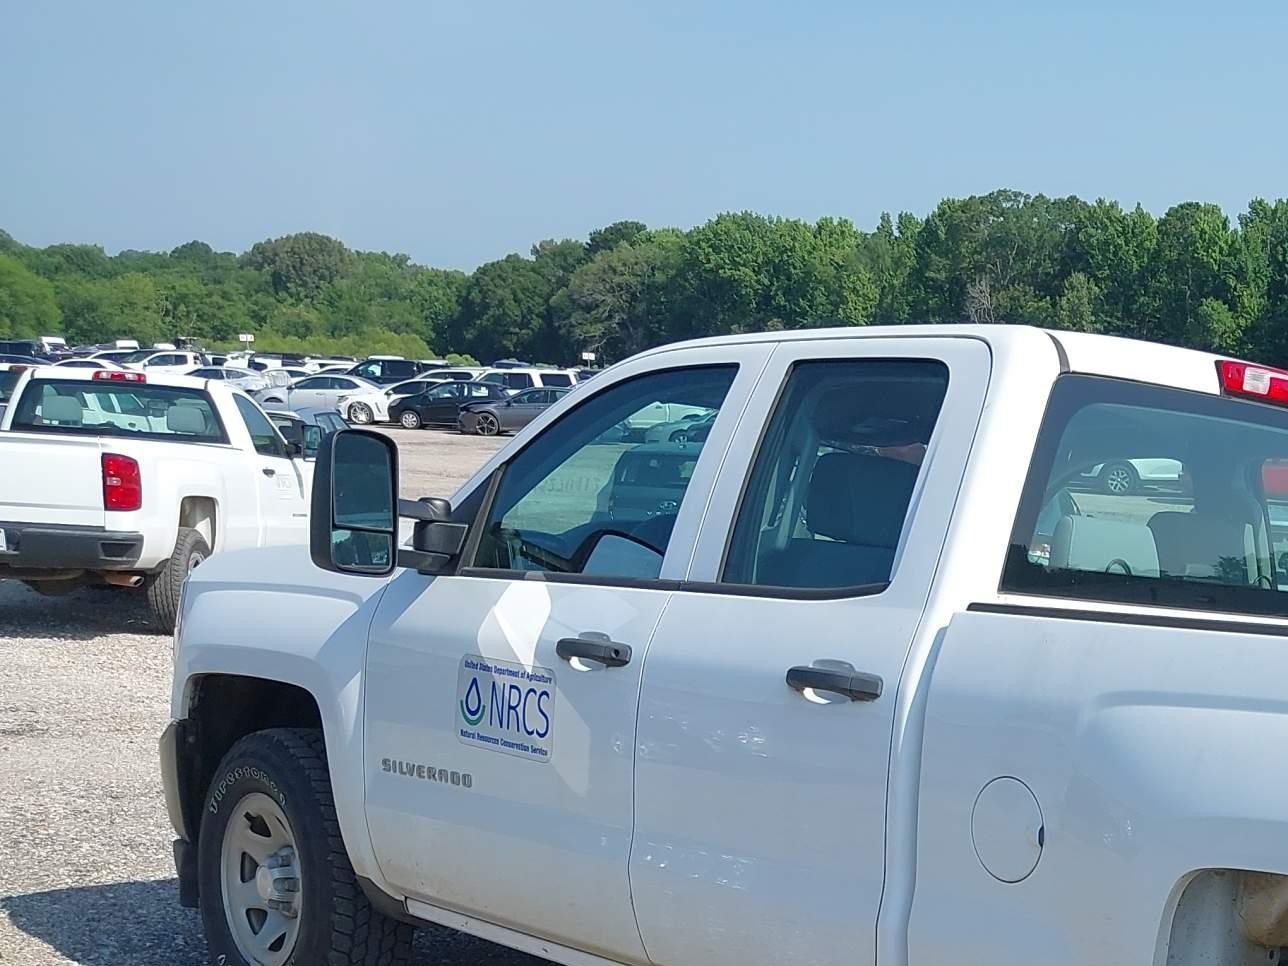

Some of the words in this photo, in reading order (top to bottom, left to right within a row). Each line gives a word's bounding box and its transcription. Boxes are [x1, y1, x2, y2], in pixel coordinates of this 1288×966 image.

[464, 660, 479, 671] United
[479, 662, 493, 674] States
[494, 665, 520, 679] Department
[489, 681, 550, 738] NRCS
[460, 729, 476, 740] Natural
[477, 732, 500, 746] Resources
[500, 738, 530, 753] Conservation
[530, 744, 548, 757] Service
[381, 758, 473, 788] SILVERADO
